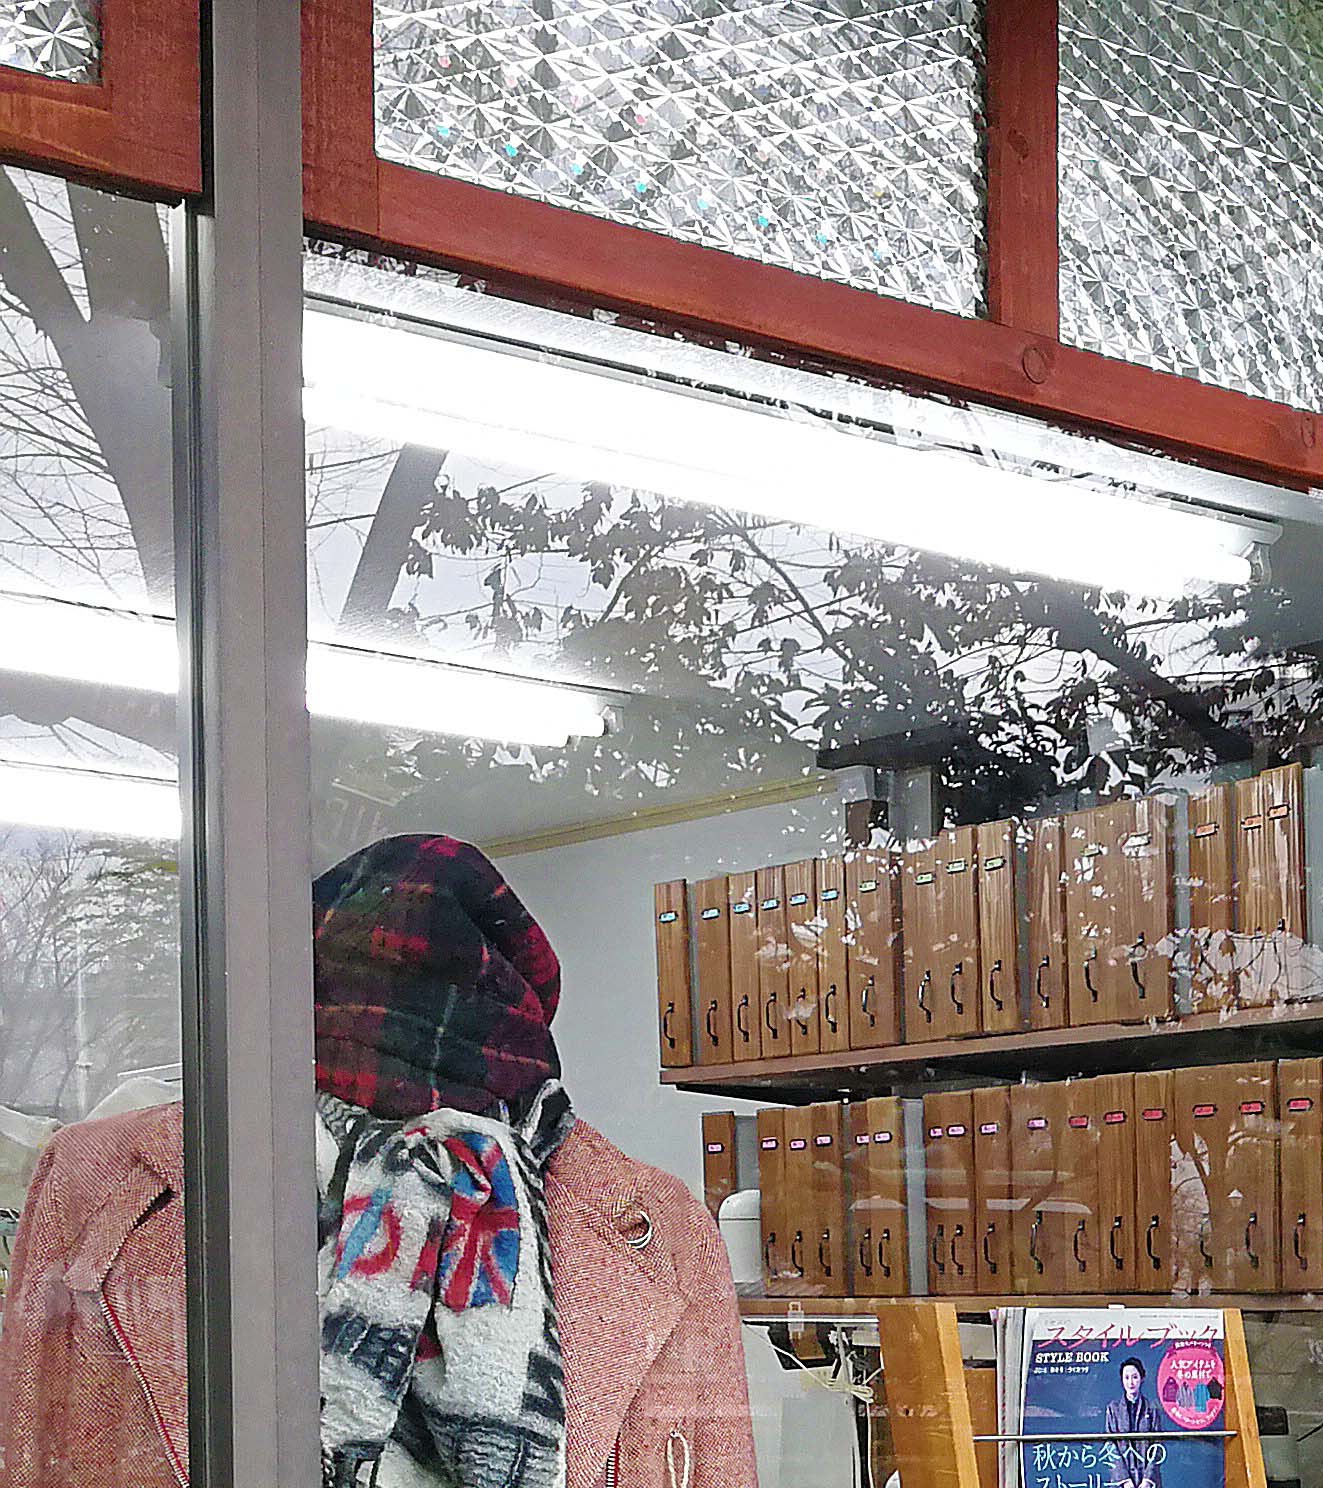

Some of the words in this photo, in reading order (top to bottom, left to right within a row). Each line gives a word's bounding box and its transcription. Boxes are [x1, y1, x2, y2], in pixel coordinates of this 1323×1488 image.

[1038, 1322, 1218, 1350] スタイルブック
[1035, 1352, 1073, 1364] STYLE
[1076, 1351, 1110, 1363] BOOK
[1032, 1442, 1167, 1472] 秋から冬への
